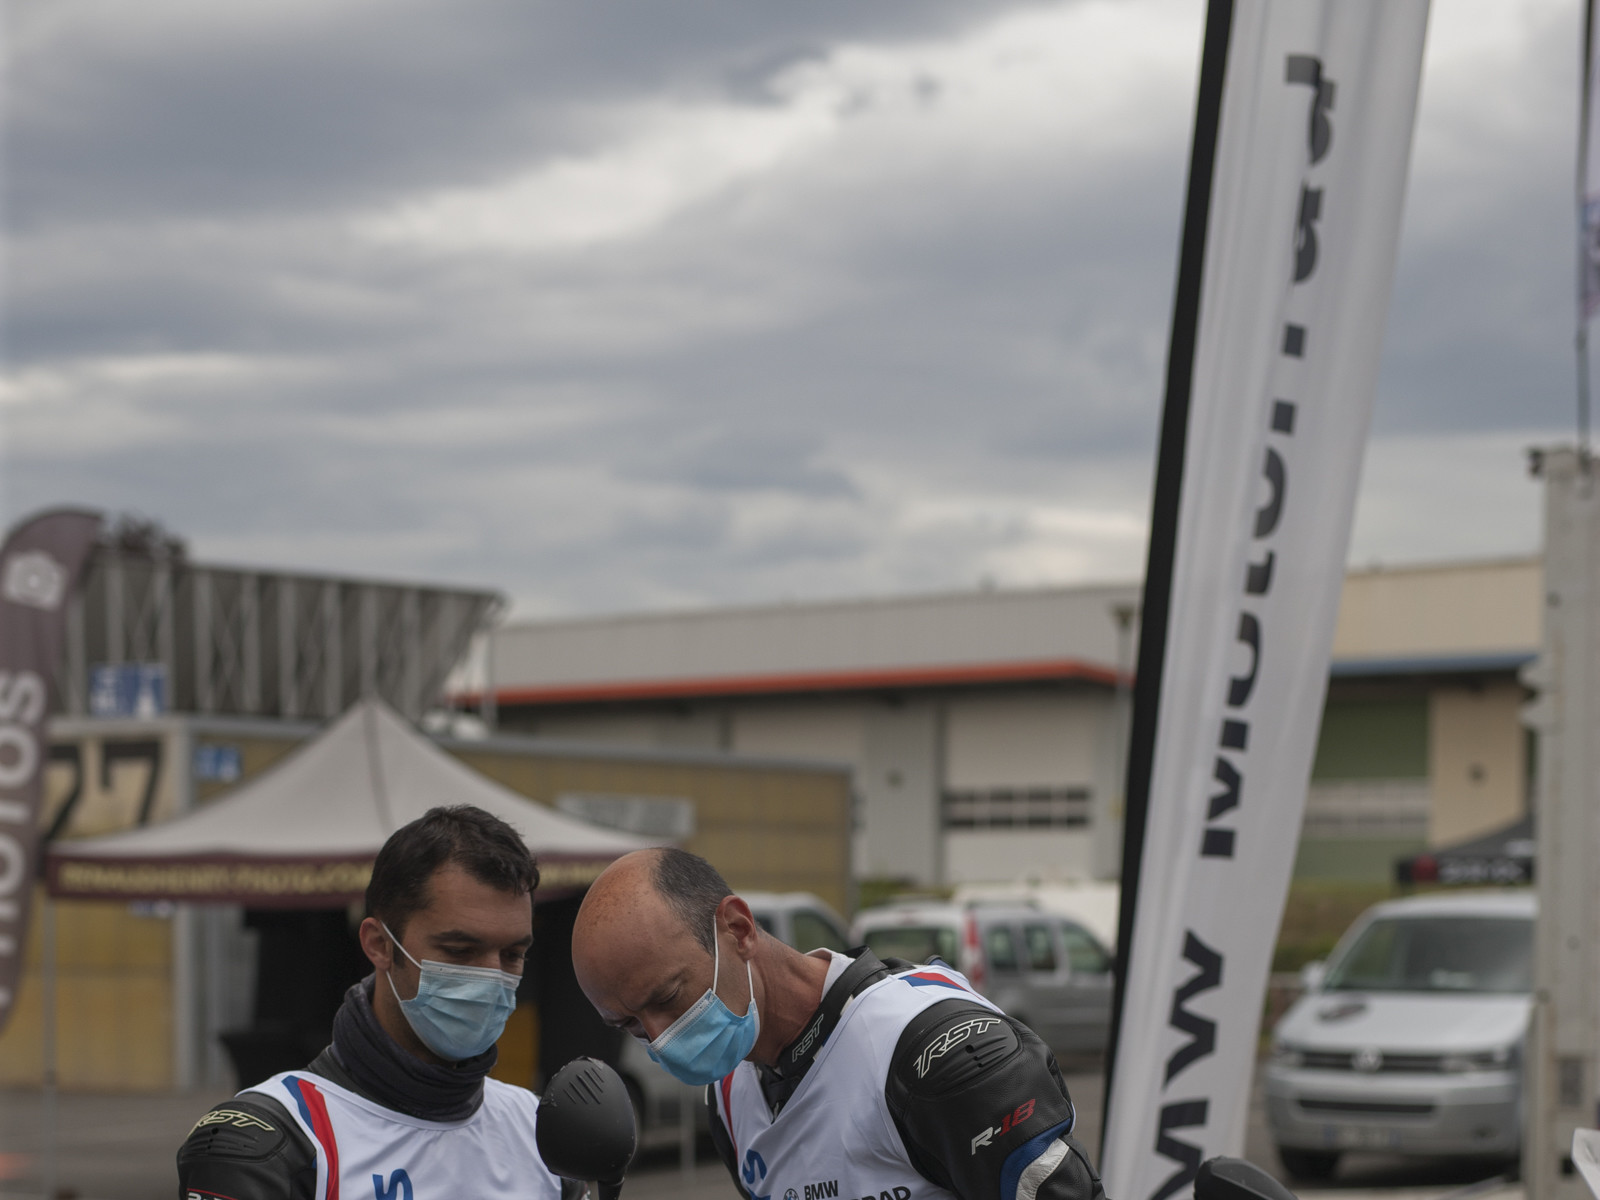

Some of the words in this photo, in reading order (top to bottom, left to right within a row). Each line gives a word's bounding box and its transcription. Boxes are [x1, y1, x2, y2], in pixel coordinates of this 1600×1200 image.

[792, 1014, 825, 1063] RST
[914, 1017, 1001, 1079] RST
[972, 1098, 1036, 1156] R-18
